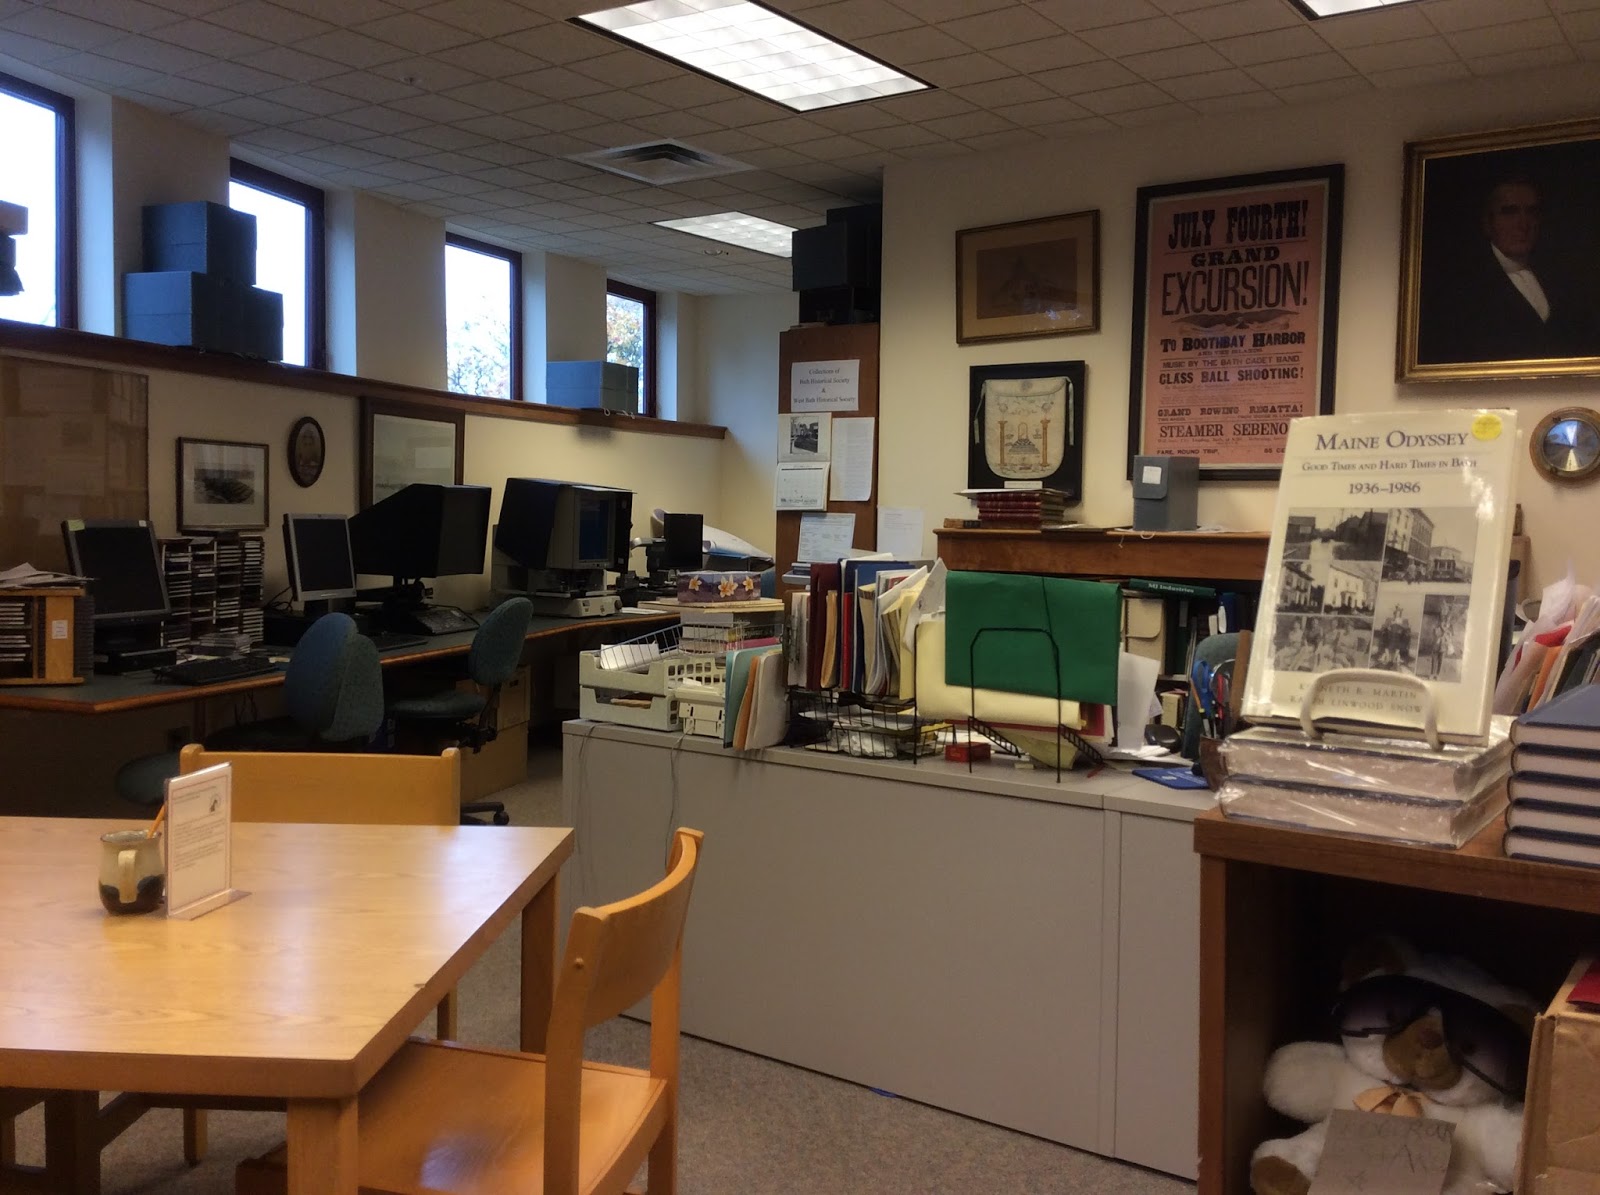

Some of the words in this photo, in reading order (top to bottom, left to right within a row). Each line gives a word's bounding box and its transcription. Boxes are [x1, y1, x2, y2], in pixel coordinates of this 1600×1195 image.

[1168, 209, 1216, 250] JULY
[1226, 199, 1309, 244] FOURTH!
[1191, 246, 1280, 268] GRAND
[1161, 260, 1310, 316] EXCURSION!
[1160, 338, 1177, 352] TO
[1182, 335, 1246, 351] BOOTHBAY
[1252, 331, 1305, 347] HARBOR
[1187, 360, 1199, 368] BY
[1202, 359, 1218, 367] THE
[1220, 358, 1243, 366] BATH
[1245, 356, 1273, 364] CADET
[1200, 370, 1230, 383] BALL
[1237, 366, 1304, 382] SHOOTING!
[1157, 408, 1192, 417] GRAND
[1159, 423, 1224, 438] STEAMER
[1315, 432, 1380, 451] MAINE
[1386, 430, 1469, 449] ODYSSEY
[1302, 462, 1329, 471] GOOD
[1331, 461, 1357, 471] TIMES
[1379, 459, 1408, 470] HARD
[1410, 458, 1438, 469] TIMES
[1438, 460, 1449, 468] IN
[1160, 584, 1195, 593] Industries
[1299, 682, 1350, 694] KNETH
[1373, 688, 1417, 698] MARTIN
[1331, 698, 1384, 711] LINWOOD
